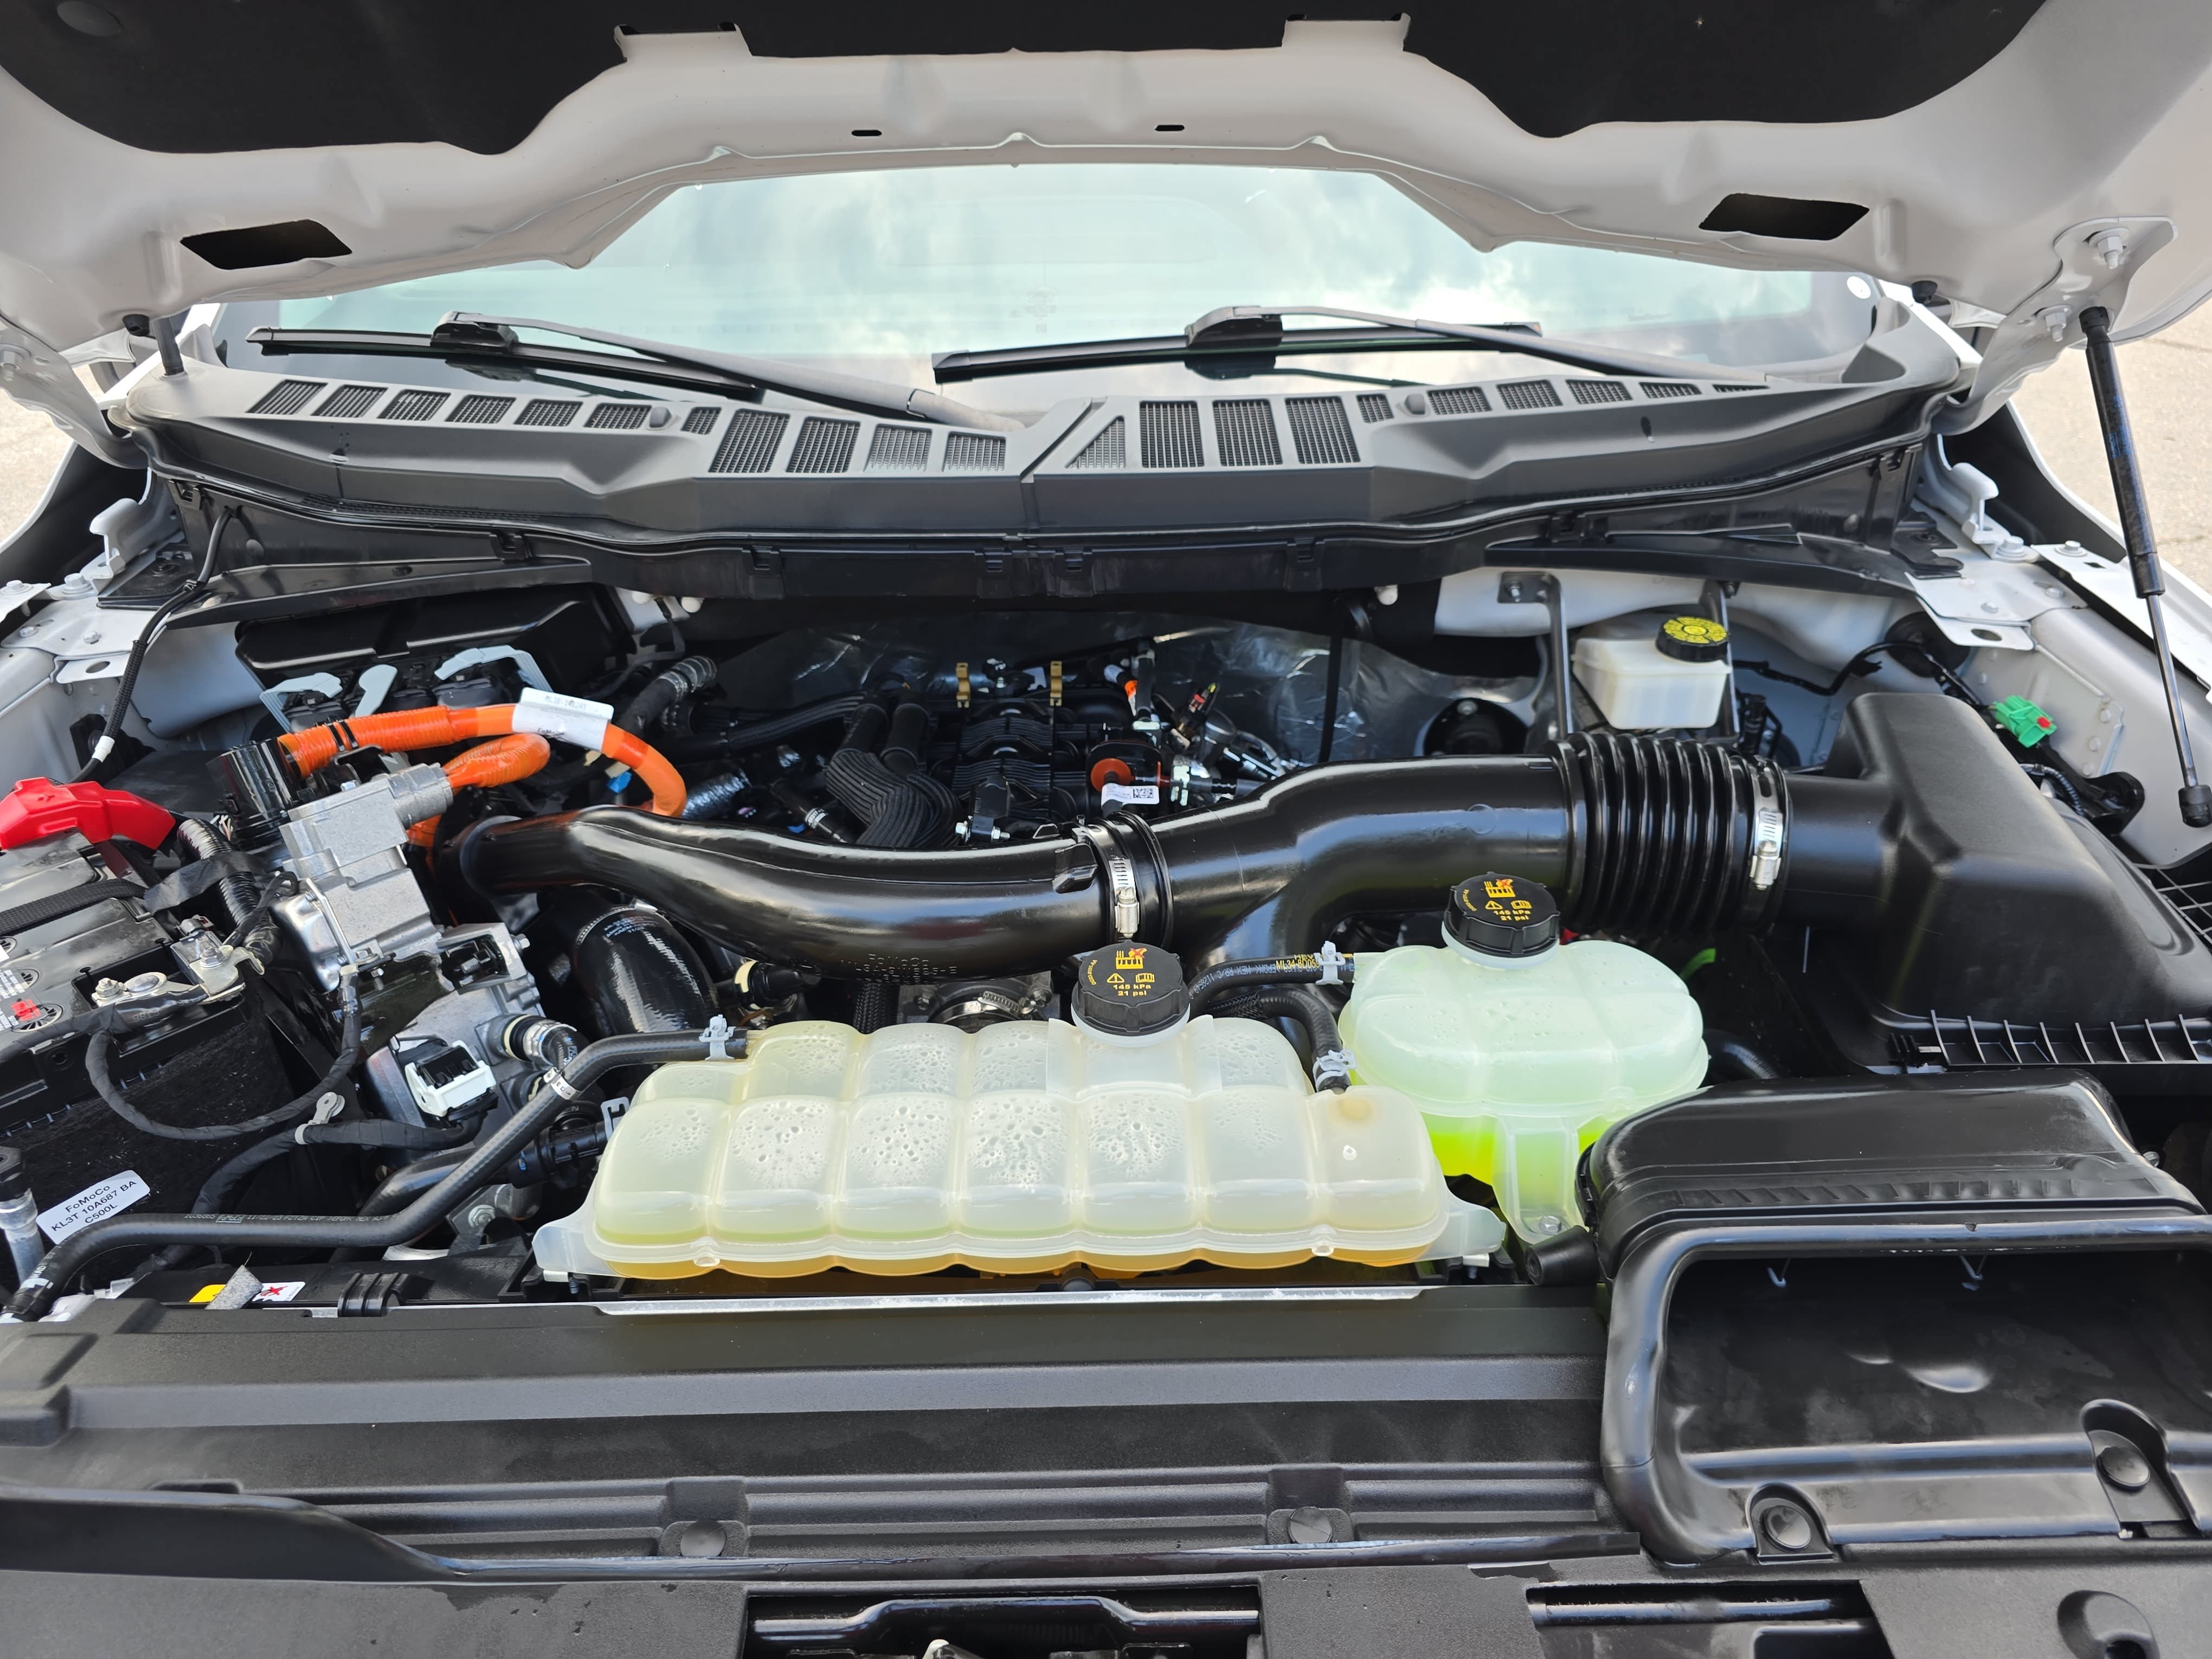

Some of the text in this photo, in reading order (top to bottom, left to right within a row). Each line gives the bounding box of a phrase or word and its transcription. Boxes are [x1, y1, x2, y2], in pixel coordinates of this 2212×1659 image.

[51, 1180, 137, 1231] KL3T 10A687 BA
[65, 1186, 110, 1212] FoMoCo
[85, 1204, 118, 1223] C500L
